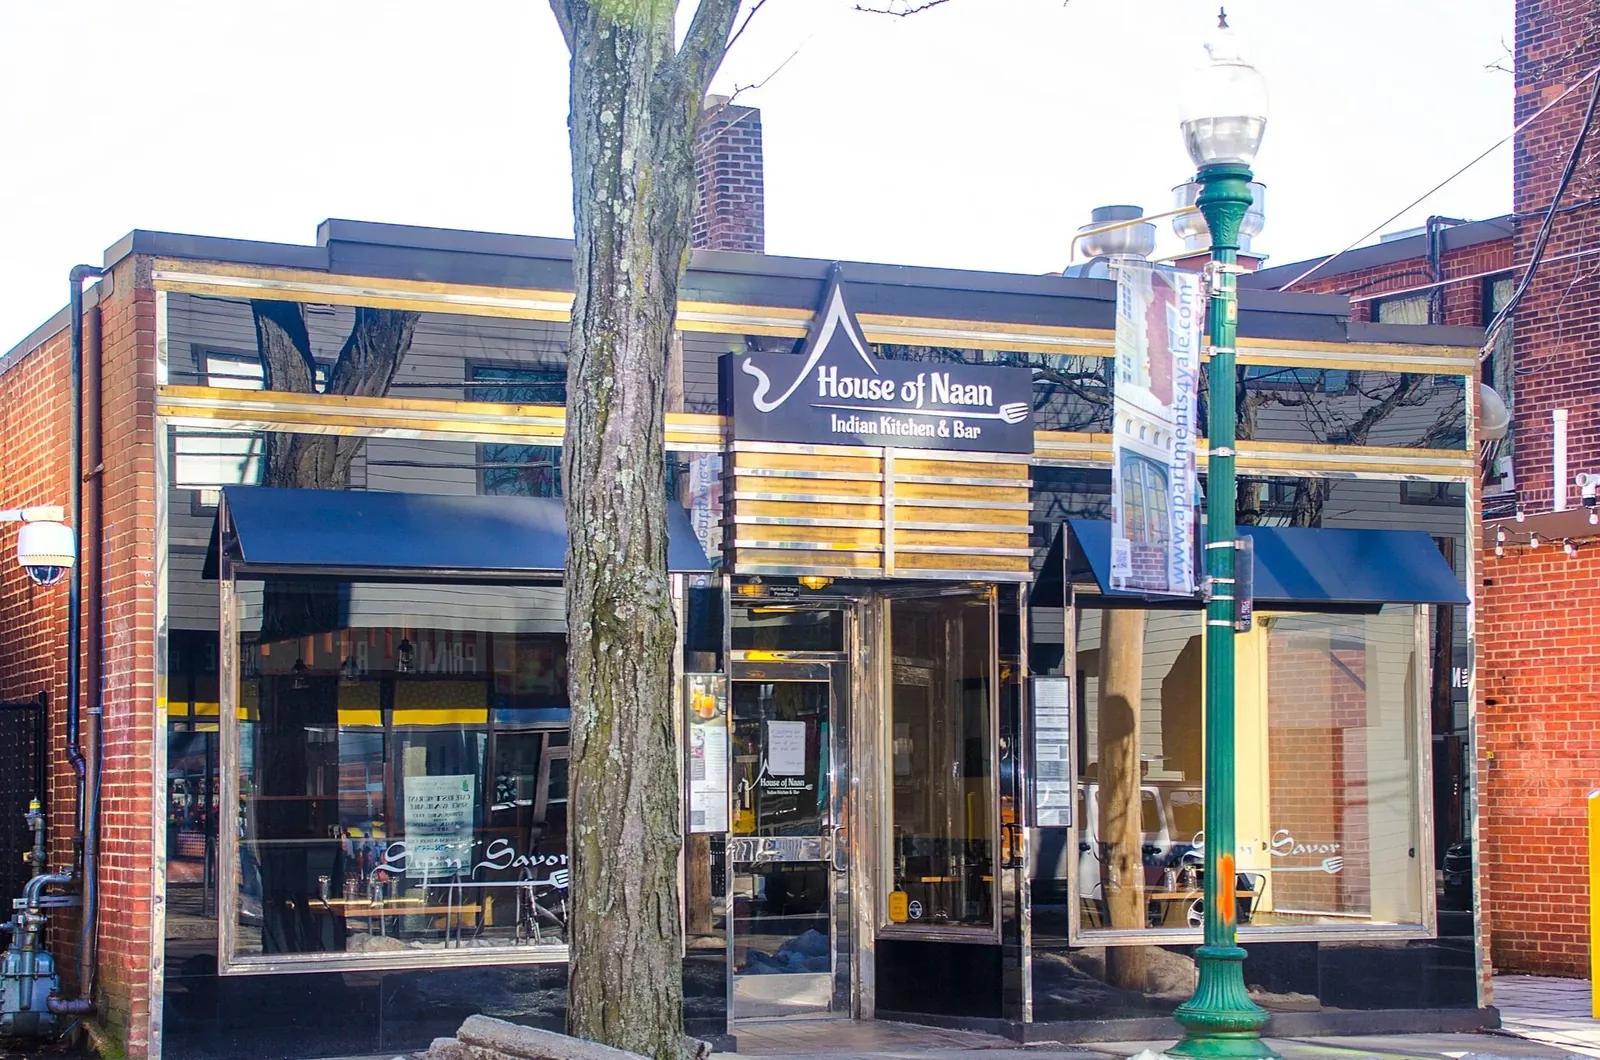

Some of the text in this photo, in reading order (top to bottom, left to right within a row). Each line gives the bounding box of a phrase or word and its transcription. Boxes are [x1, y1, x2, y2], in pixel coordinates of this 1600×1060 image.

[817, 365, 994, 408] House of Naan
[831, 414, 981, 440] Indian Kitchen & Bar
[1171, 284, 1195, 585] www.apartments4yale.com
[760, 778, 805, 788] House of Naan
[472, 838, 568, 880] Savor
[1268, 829, 1340, 857] Savor
